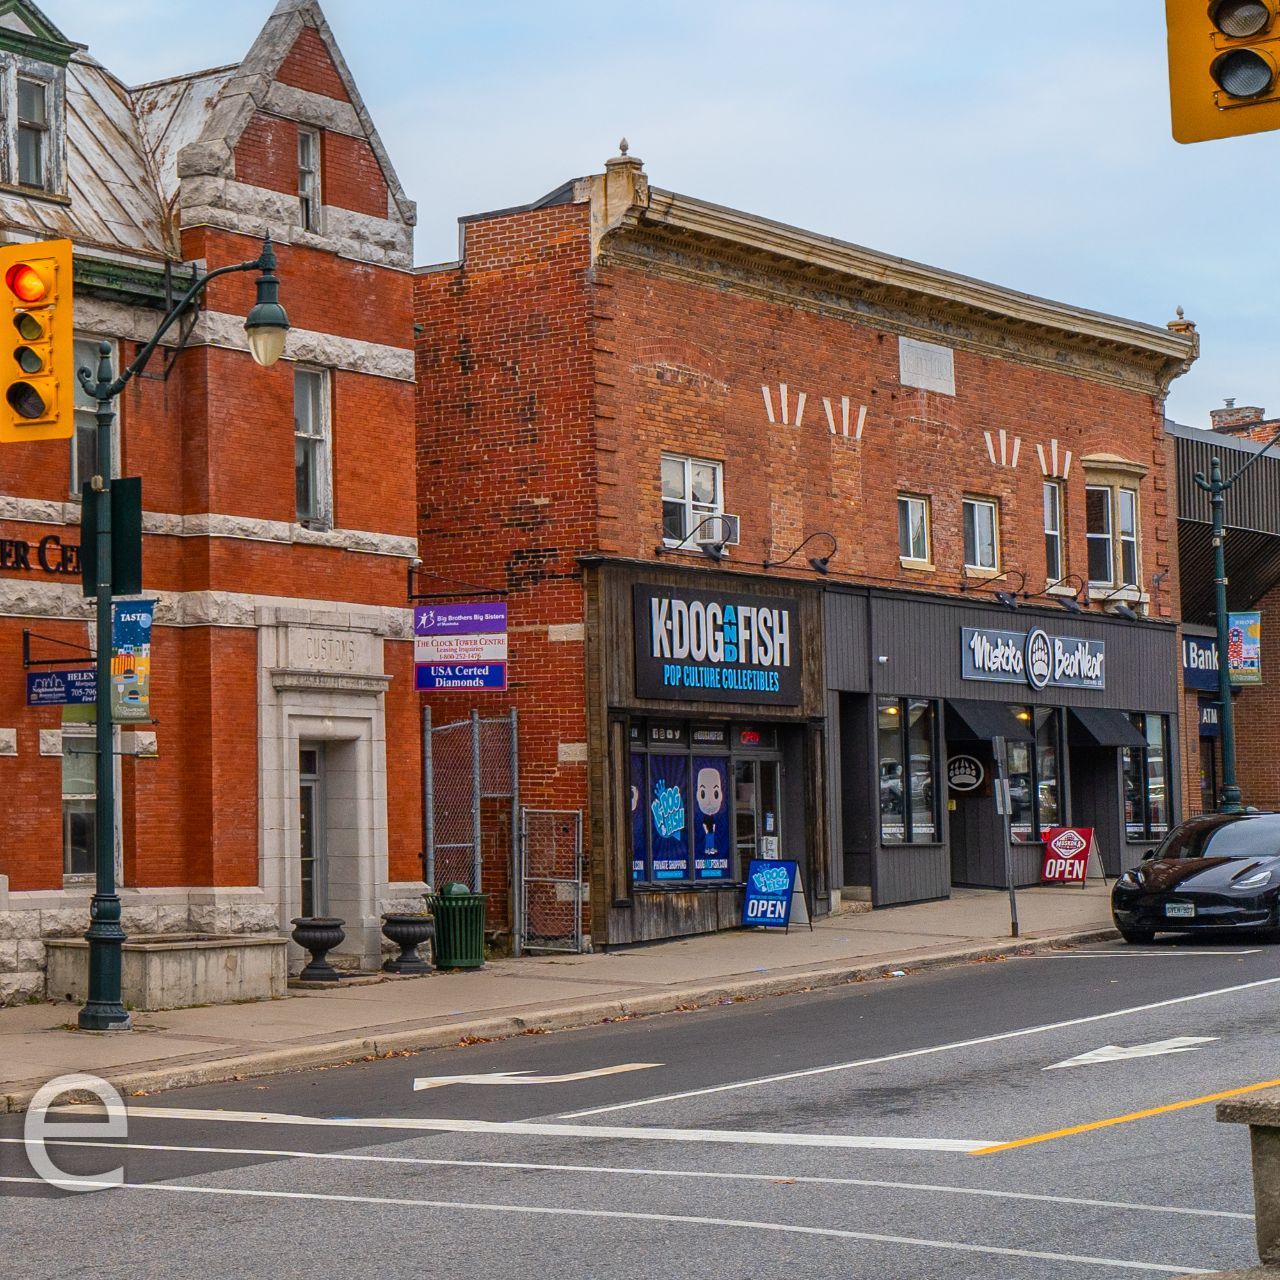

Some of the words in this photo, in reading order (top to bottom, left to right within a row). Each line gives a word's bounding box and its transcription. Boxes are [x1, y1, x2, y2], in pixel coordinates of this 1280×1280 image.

[120, 613, 147, 622] TASTE
[473, 613, 484, 621] Big
[417, 639, 430, 648] THE
[431, 639, 453, 647] CLOCK
[455, 638, 478, 646] TOWER
[479, 637, 505, 646] CENTRE
[736, 606, 791, 667] FISH
[306, 637, 355, 663] CUSTOMS
[969, 631, 1024, 674] Muskoka
[1189, 641, 1219, 671] Bank
[67, 672, 95, 681] HELEN
[430, 666, 453, 676] USA
[455, 665, 489, 676] Certed
[663, 664, 682, 686] POP
[683, 665, 721, 689] CULTURE
[721, 668, 780, 693] COLLECTIBLES
[435, 677, 484, 687] Diamonds
[1202, 707, 1218, 724] ATM
[1045, 858, 1085, 879] OPEN
[747, 899, 787, 919] OPEN
